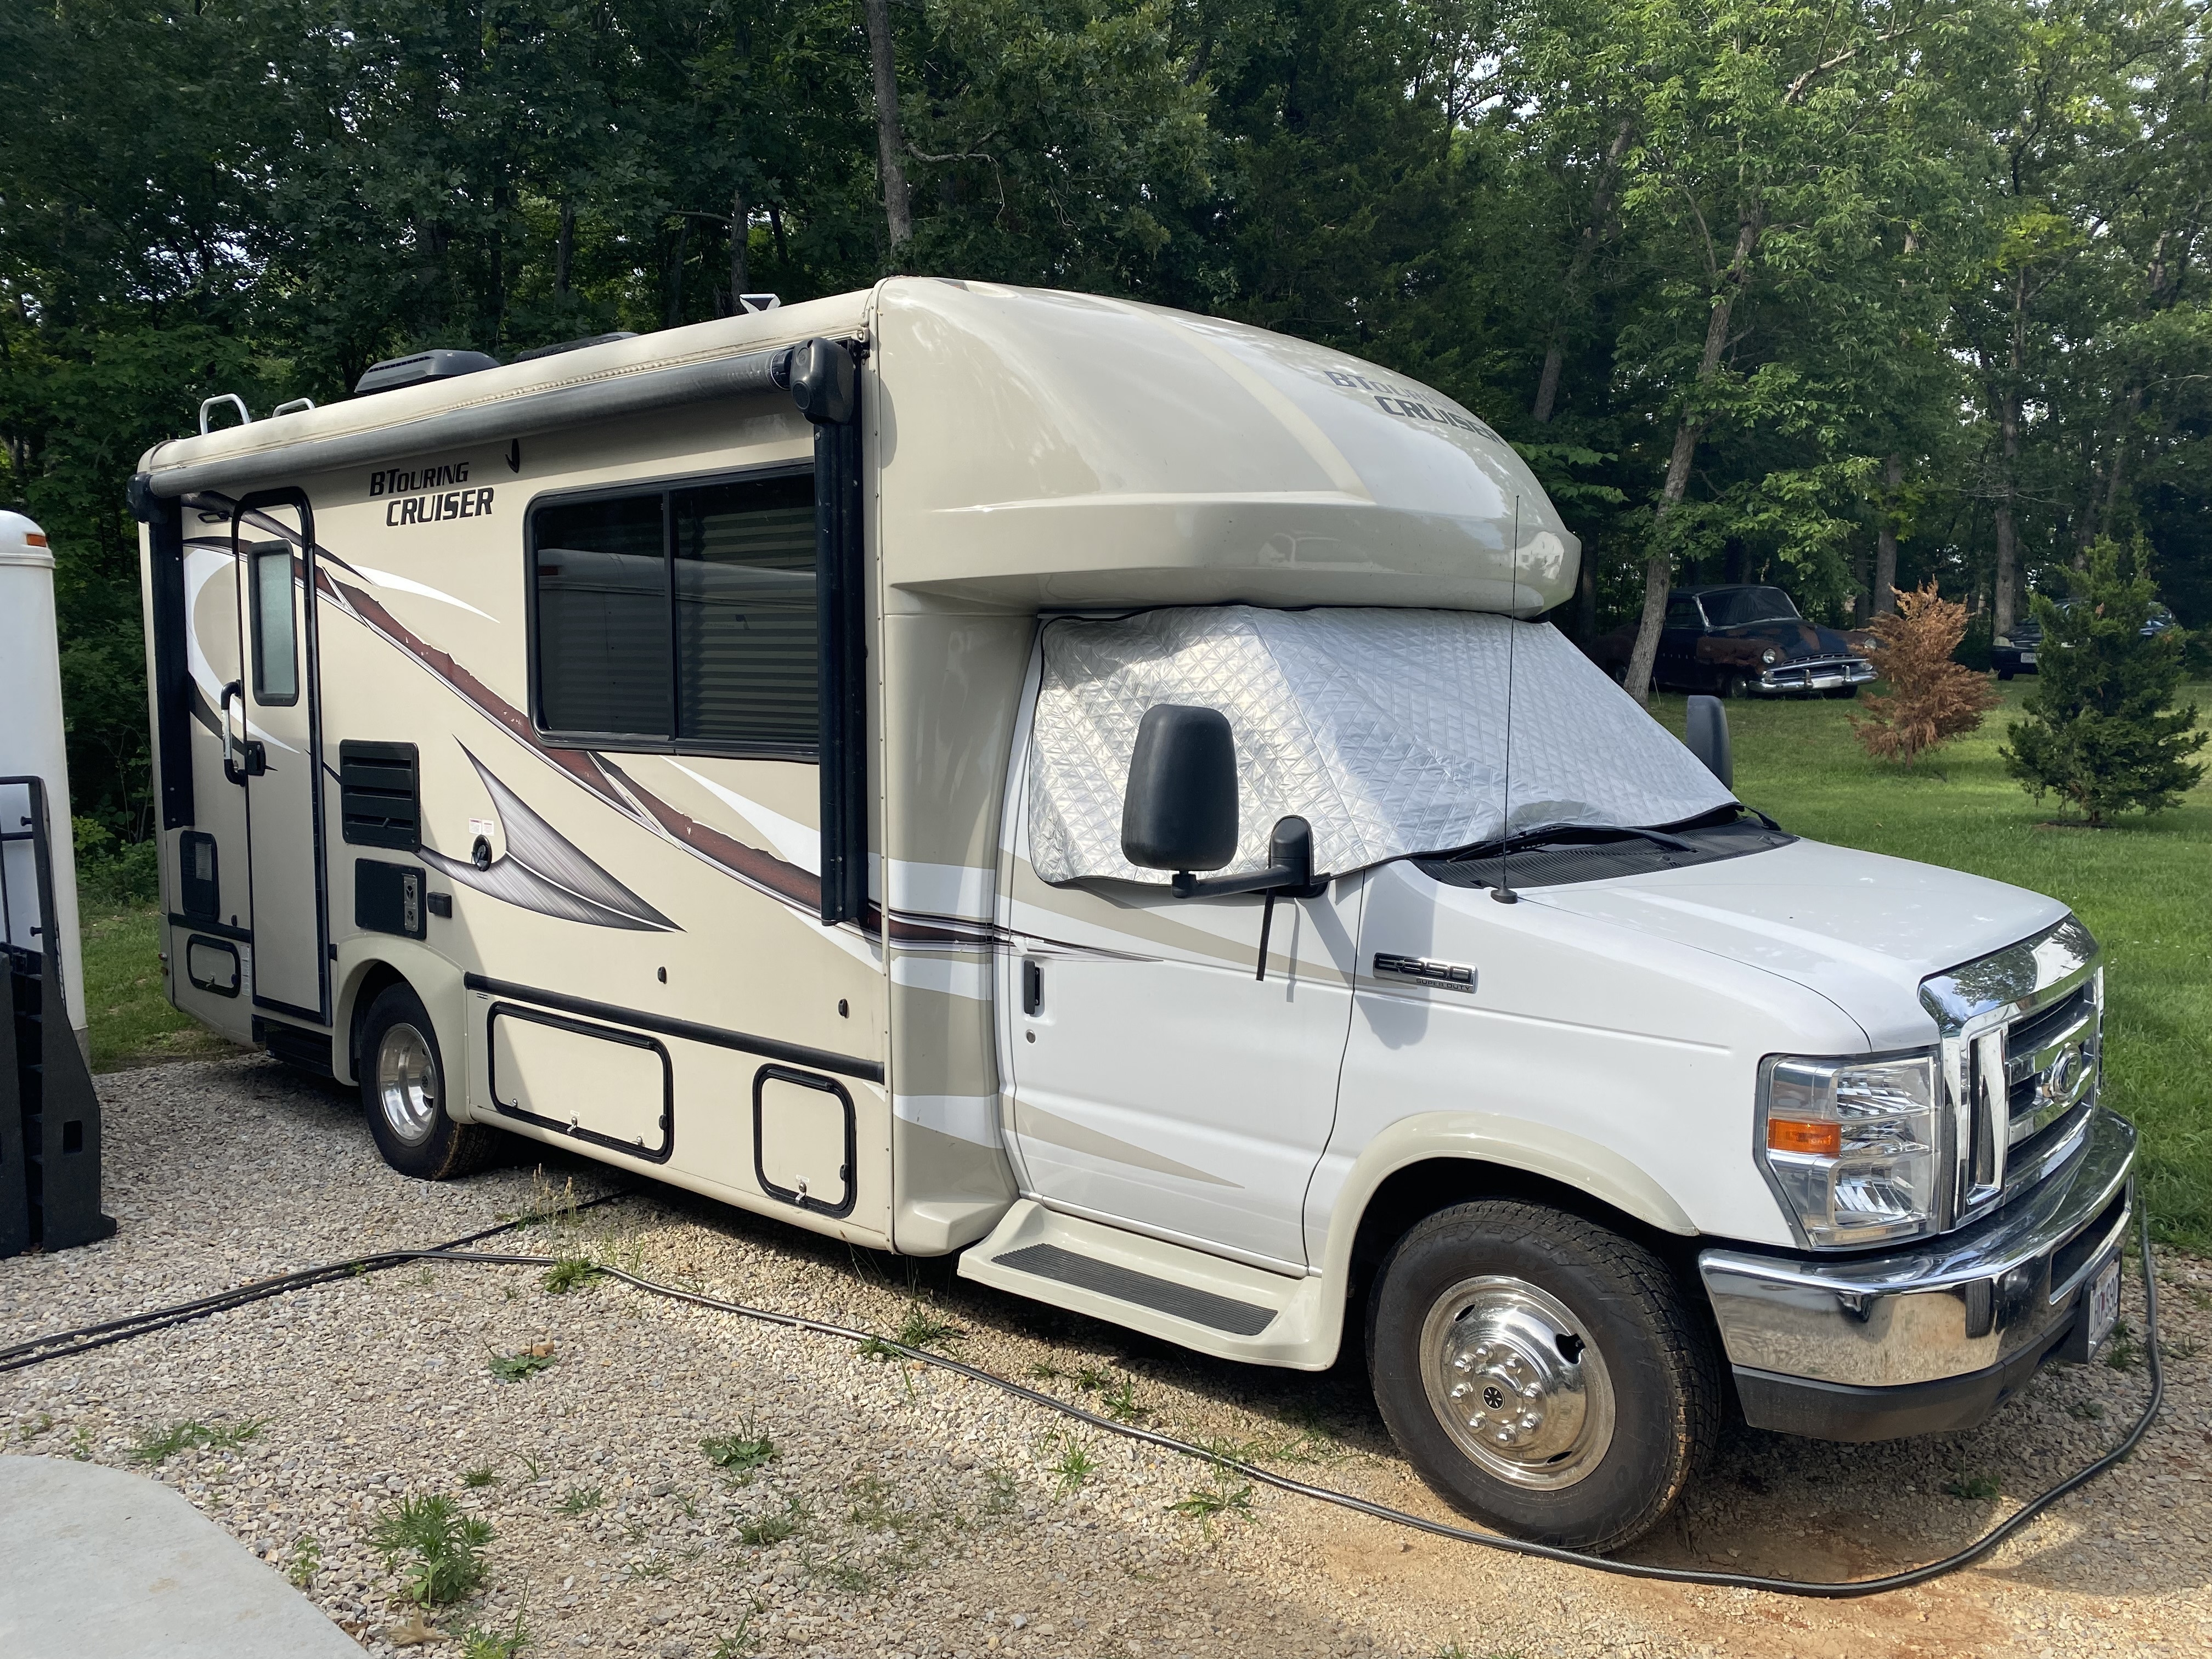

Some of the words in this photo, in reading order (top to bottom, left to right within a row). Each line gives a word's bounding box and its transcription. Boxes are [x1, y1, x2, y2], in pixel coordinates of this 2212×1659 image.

[1374, 395, 1508, 448] CRUISER
[386, 487, 494, 527] CRUISER
[1416, 978, 1444, 988] SUPER
